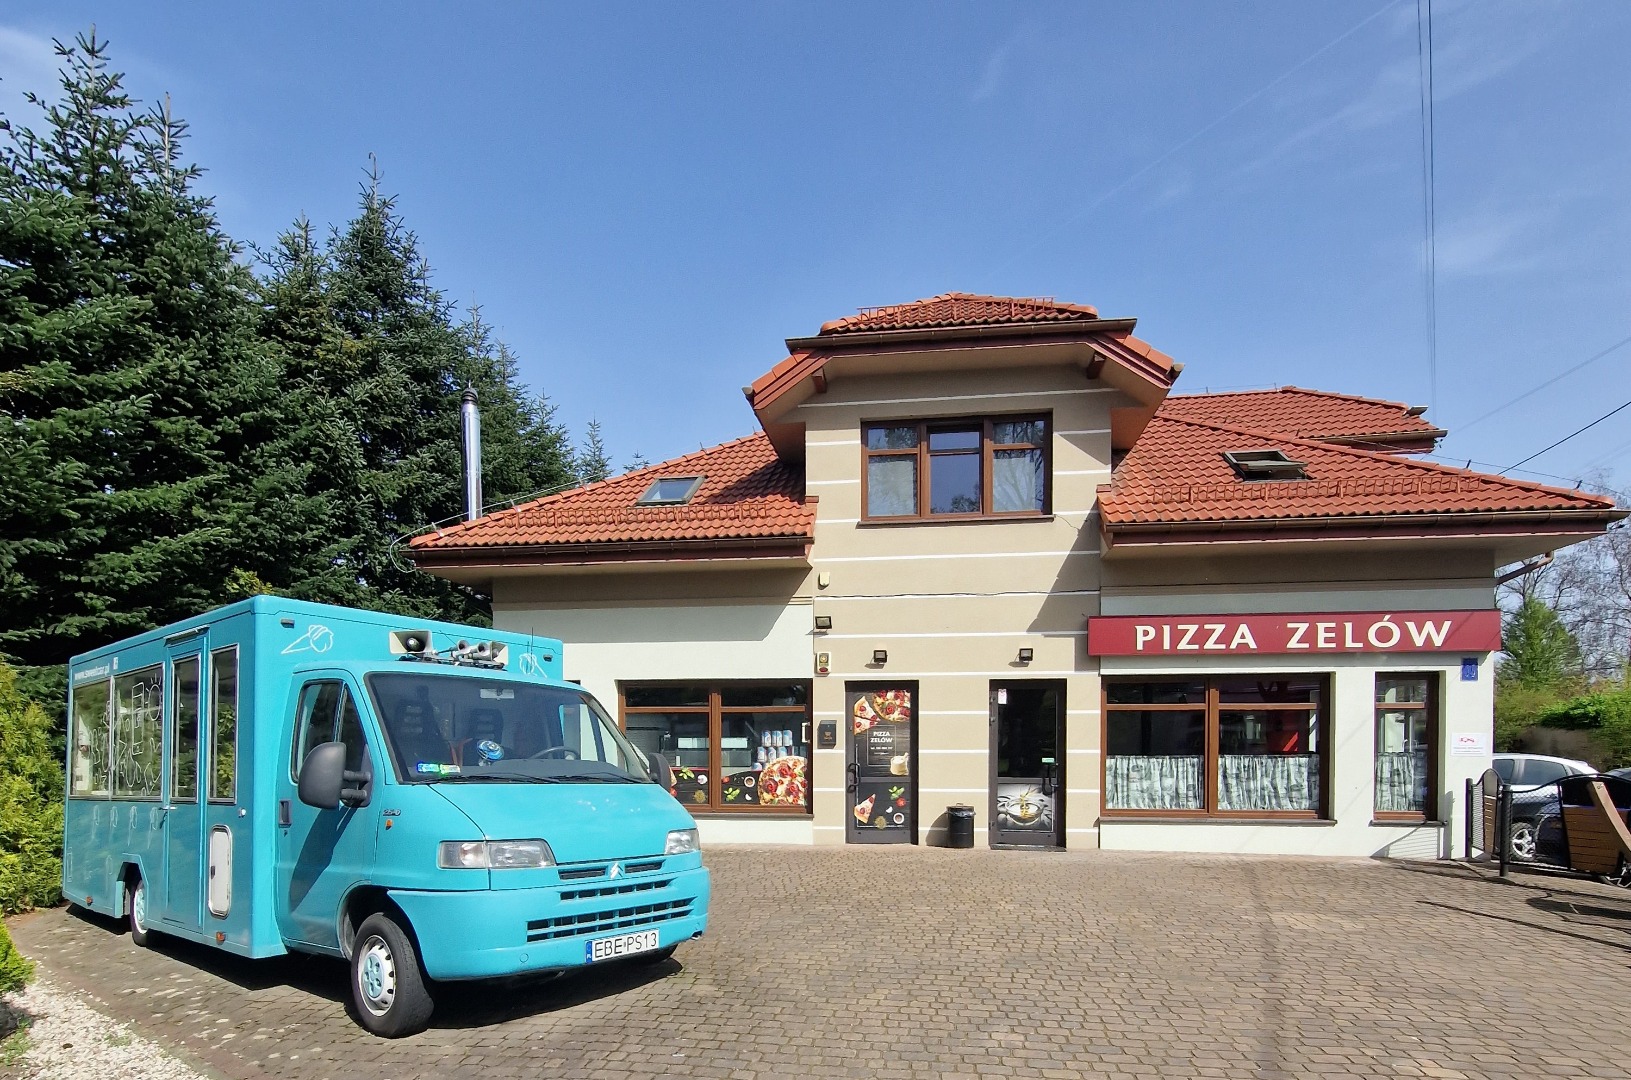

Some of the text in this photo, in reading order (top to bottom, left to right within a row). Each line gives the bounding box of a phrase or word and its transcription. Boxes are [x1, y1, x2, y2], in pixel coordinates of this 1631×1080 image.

[1134, 615, 1452, 650] PIZZA ZELÓW
[594, 932, 657, 959] EBE PS13
